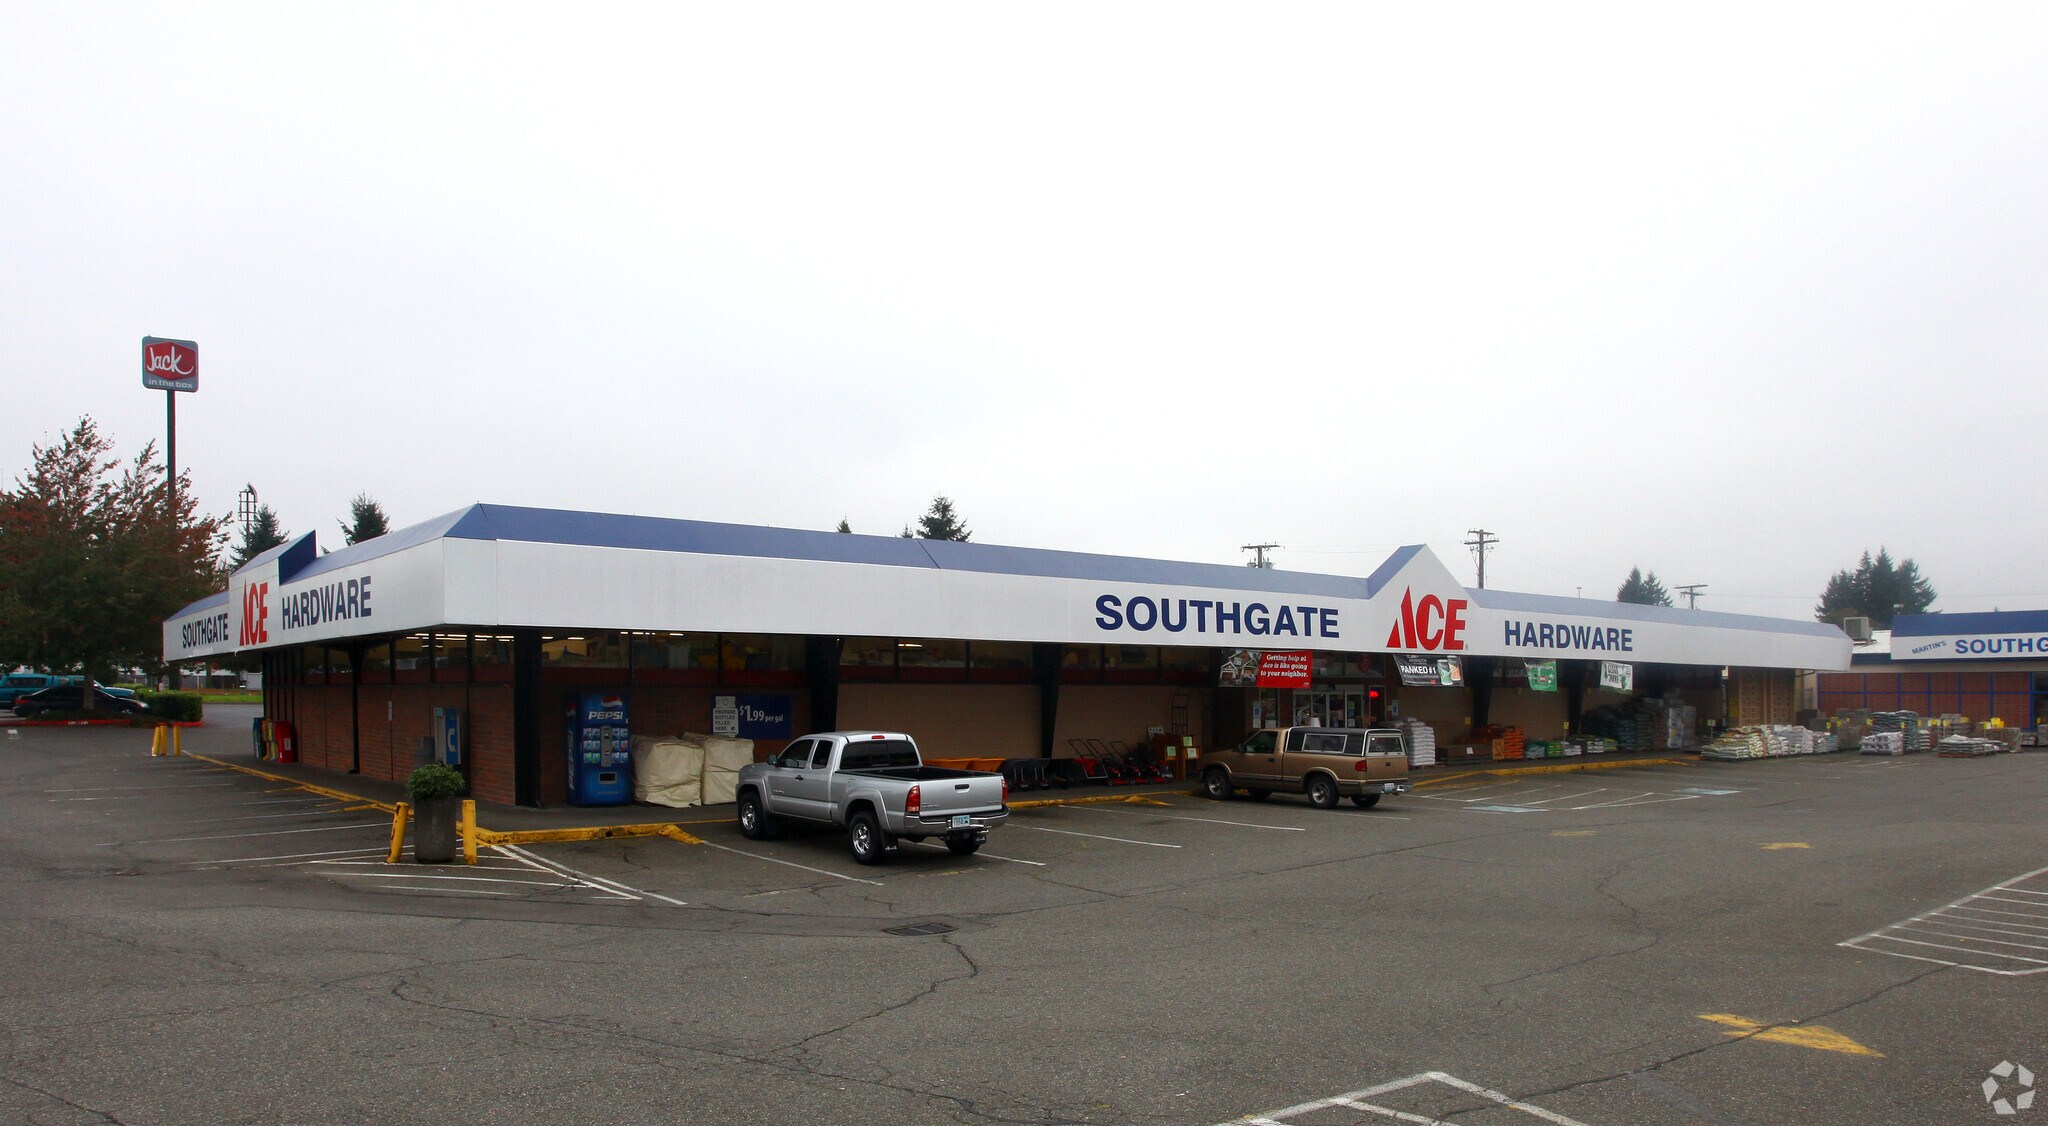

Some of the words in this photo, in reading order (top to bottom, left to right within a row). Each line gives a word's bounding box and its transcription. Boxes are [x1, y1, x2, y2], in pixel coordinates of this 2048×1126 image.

[146, 346, 195, 375] Jack
[176, 381, 193, 389] box
[182, 612, 229, 649] SOUTHGATE
[239, 577, 269, 647] ACE
[282, 575, 372, 630] HARDWARE
[1095, 594, 1340, 638] SOUTHGATE
[1386, 584, 1468, 651] ACE
[1504, 620, 1633, 652] HARDWARE
[1911, 640, 1947, 655] MARTIN'S
[1266, 654, 1287, 662] Getting
[588, 711, 624, 720] PEPSI
[739, 704, 765, 722] $1.99
[774, 714, 784, 723] gal
